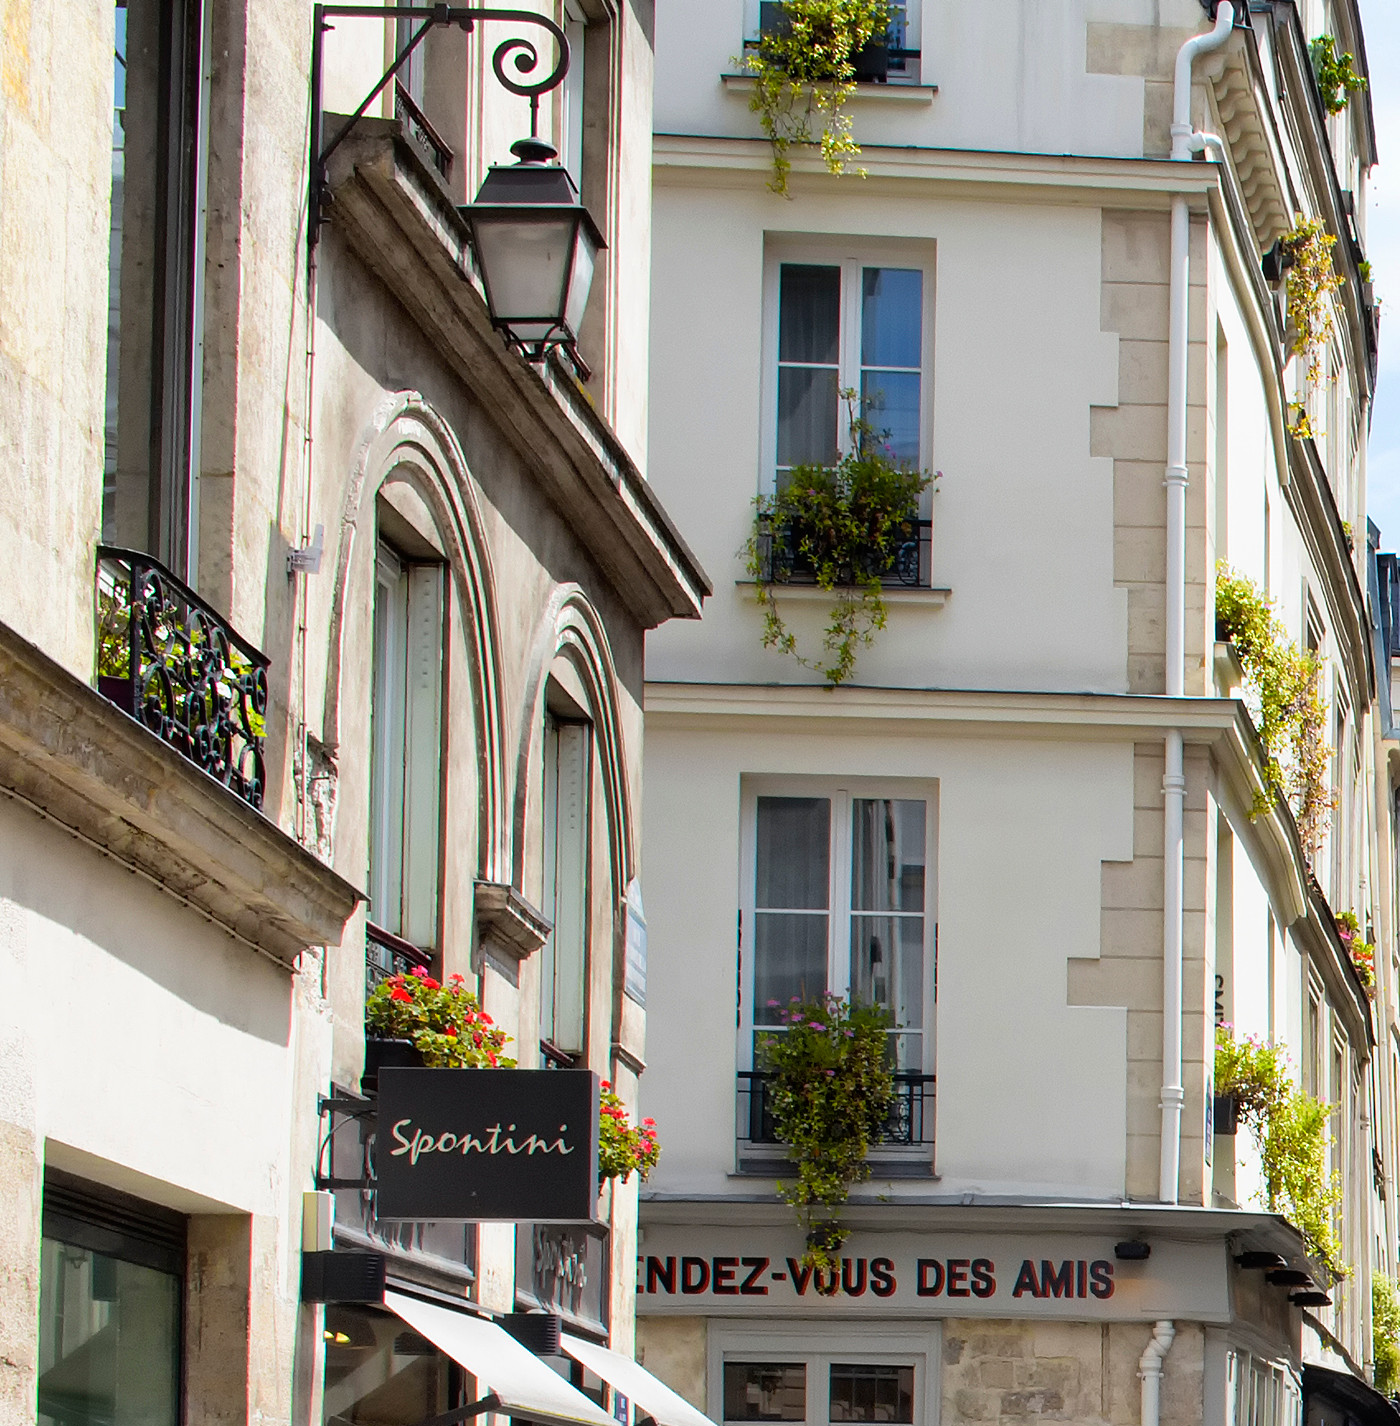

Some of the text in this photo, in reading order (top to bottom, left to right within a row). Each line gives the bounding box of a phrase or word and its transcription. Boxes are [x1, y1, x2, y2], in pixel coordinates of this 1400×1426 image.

[390, 1118, 575, 1166] Spontini
[917, 1258, 998, 1299] DES
[1012, 1259, 1116, 1299] AMIS
